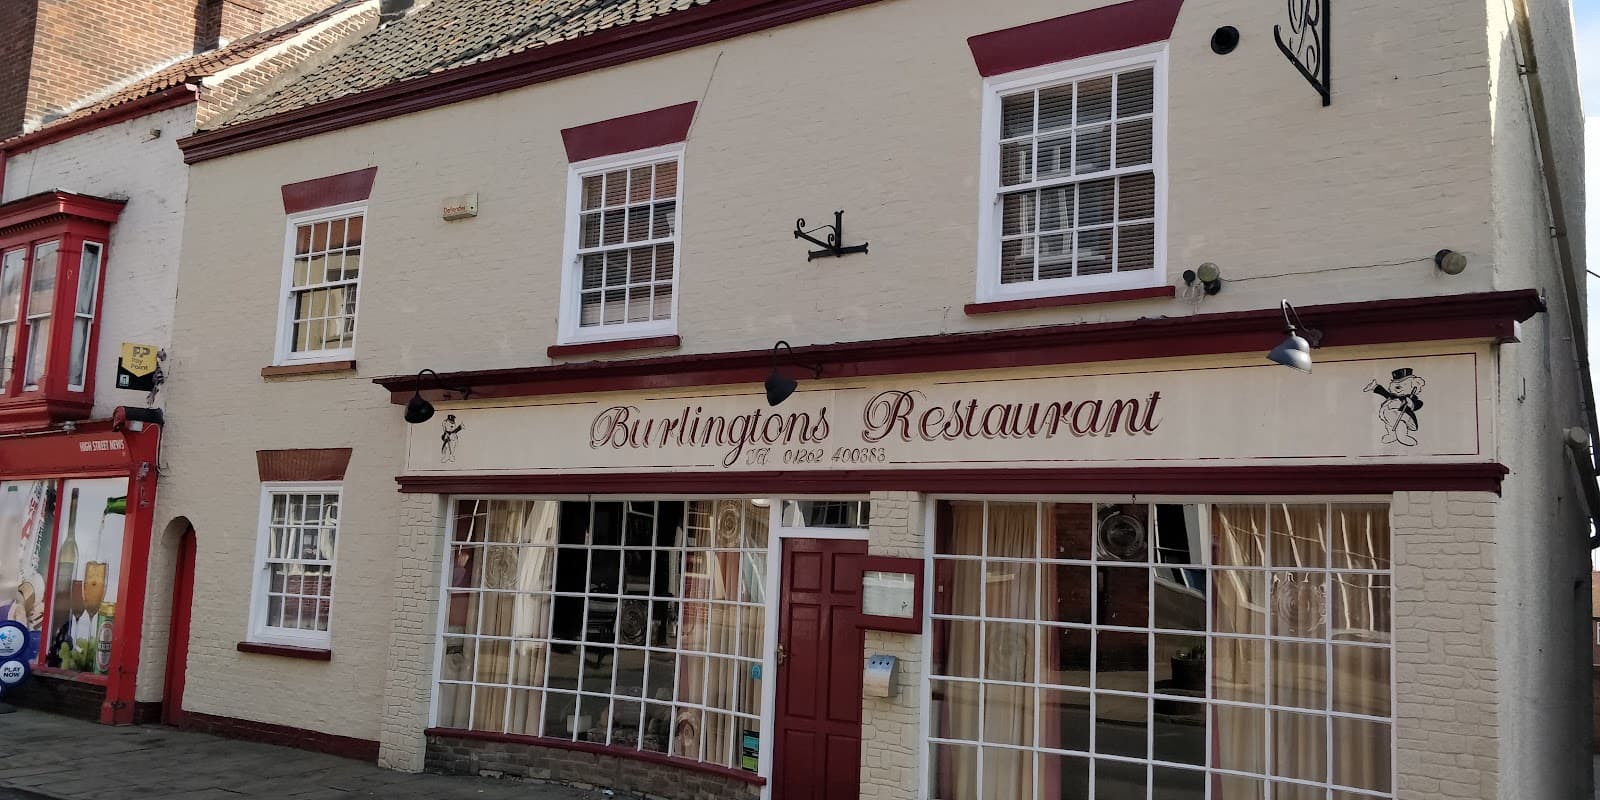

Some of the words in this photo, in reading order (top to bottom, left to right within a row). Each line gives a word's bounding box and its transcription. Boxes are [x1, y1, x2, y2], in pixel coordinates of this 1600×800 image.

[589, 405, 830, 468] Burlingtons
[861, 390, 1165, 442] Restaurant
[80, 441, 92, 452] HIGH
[93, 440, 109, 451] STREET
[110, 439, 125, 450] NEWS
[783, 449, 824, 465] 01262
[831, 447, 886, 465] 400383
